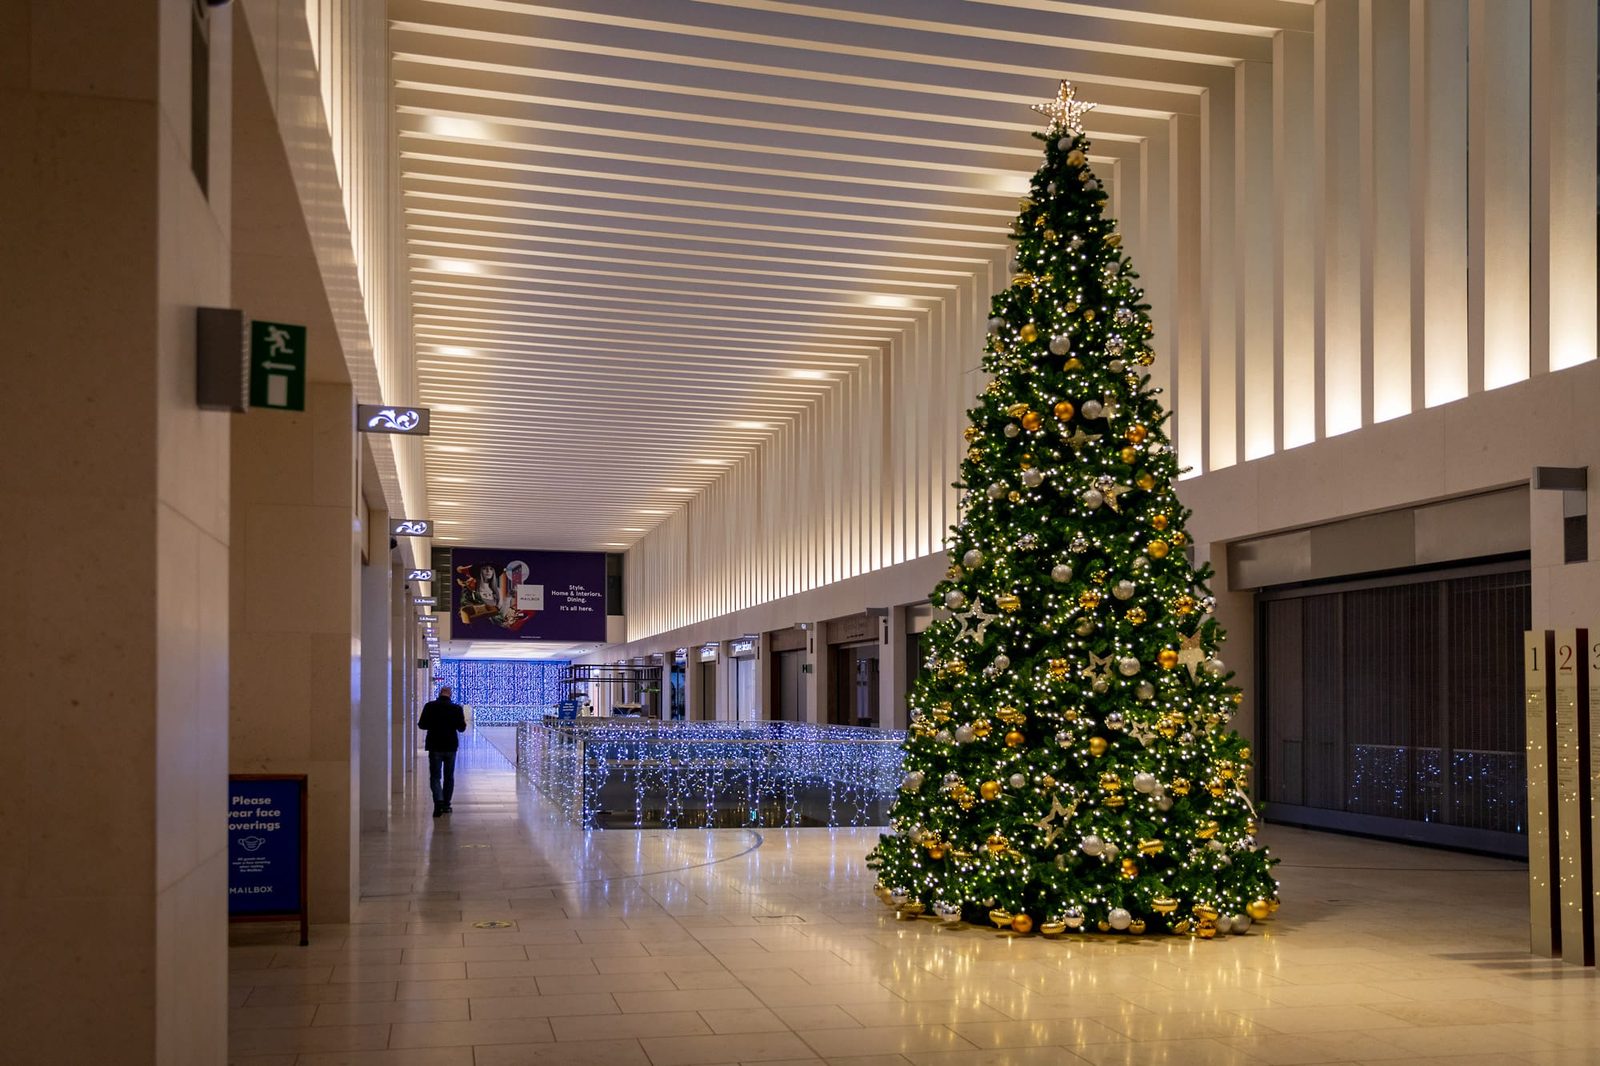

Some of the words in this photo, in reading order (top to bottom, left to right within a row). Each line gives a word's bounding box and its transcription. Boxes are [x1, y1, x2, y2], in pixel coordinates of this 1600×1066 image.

[1531, 646, 1539, 671] 1
[1559, 645, 1572, 671] 2
[232, 796, 272, 805] Please
[255, 807, 281, 817] face
[228, 820, 281, 831] overings
[229, 885, 273, 895] MAILBOX
